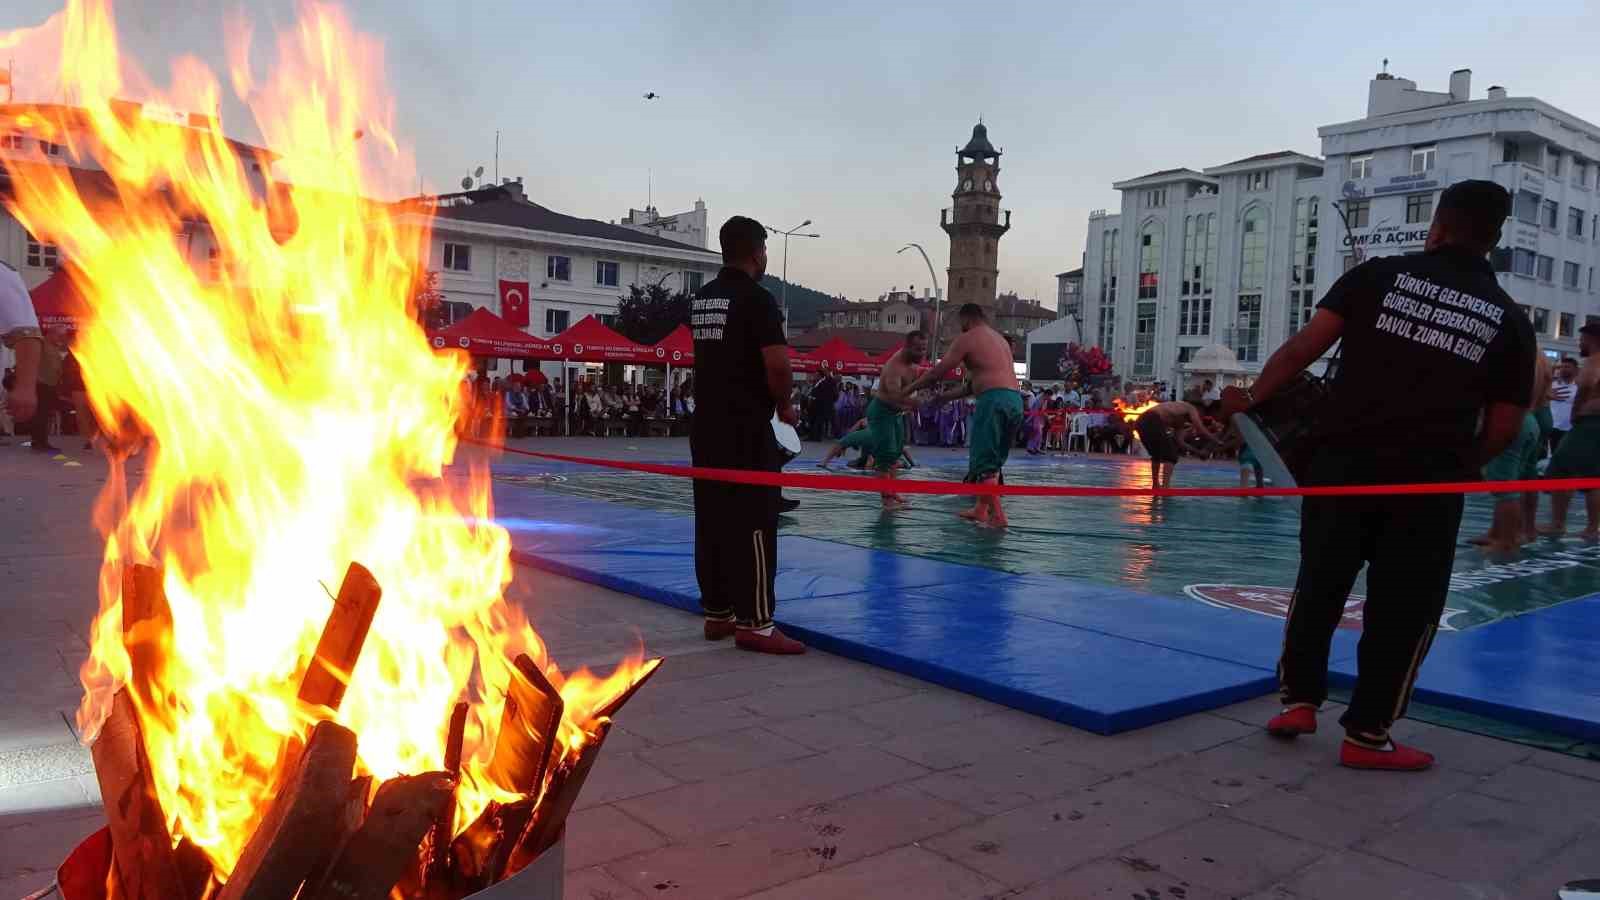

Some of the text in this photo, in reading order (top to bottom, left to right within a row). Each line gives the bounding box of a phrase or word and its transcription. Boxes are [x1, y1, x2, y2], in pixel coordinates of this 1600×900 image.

[1383, 290, 1498, 344] GÜREŞLER FEDERASYONU
[1393, 271, 1504, 325] TÜRKİYE GELENEKSEL
[1375, 313, 1486, 364] DAVUL ZURNA EKİBİ
